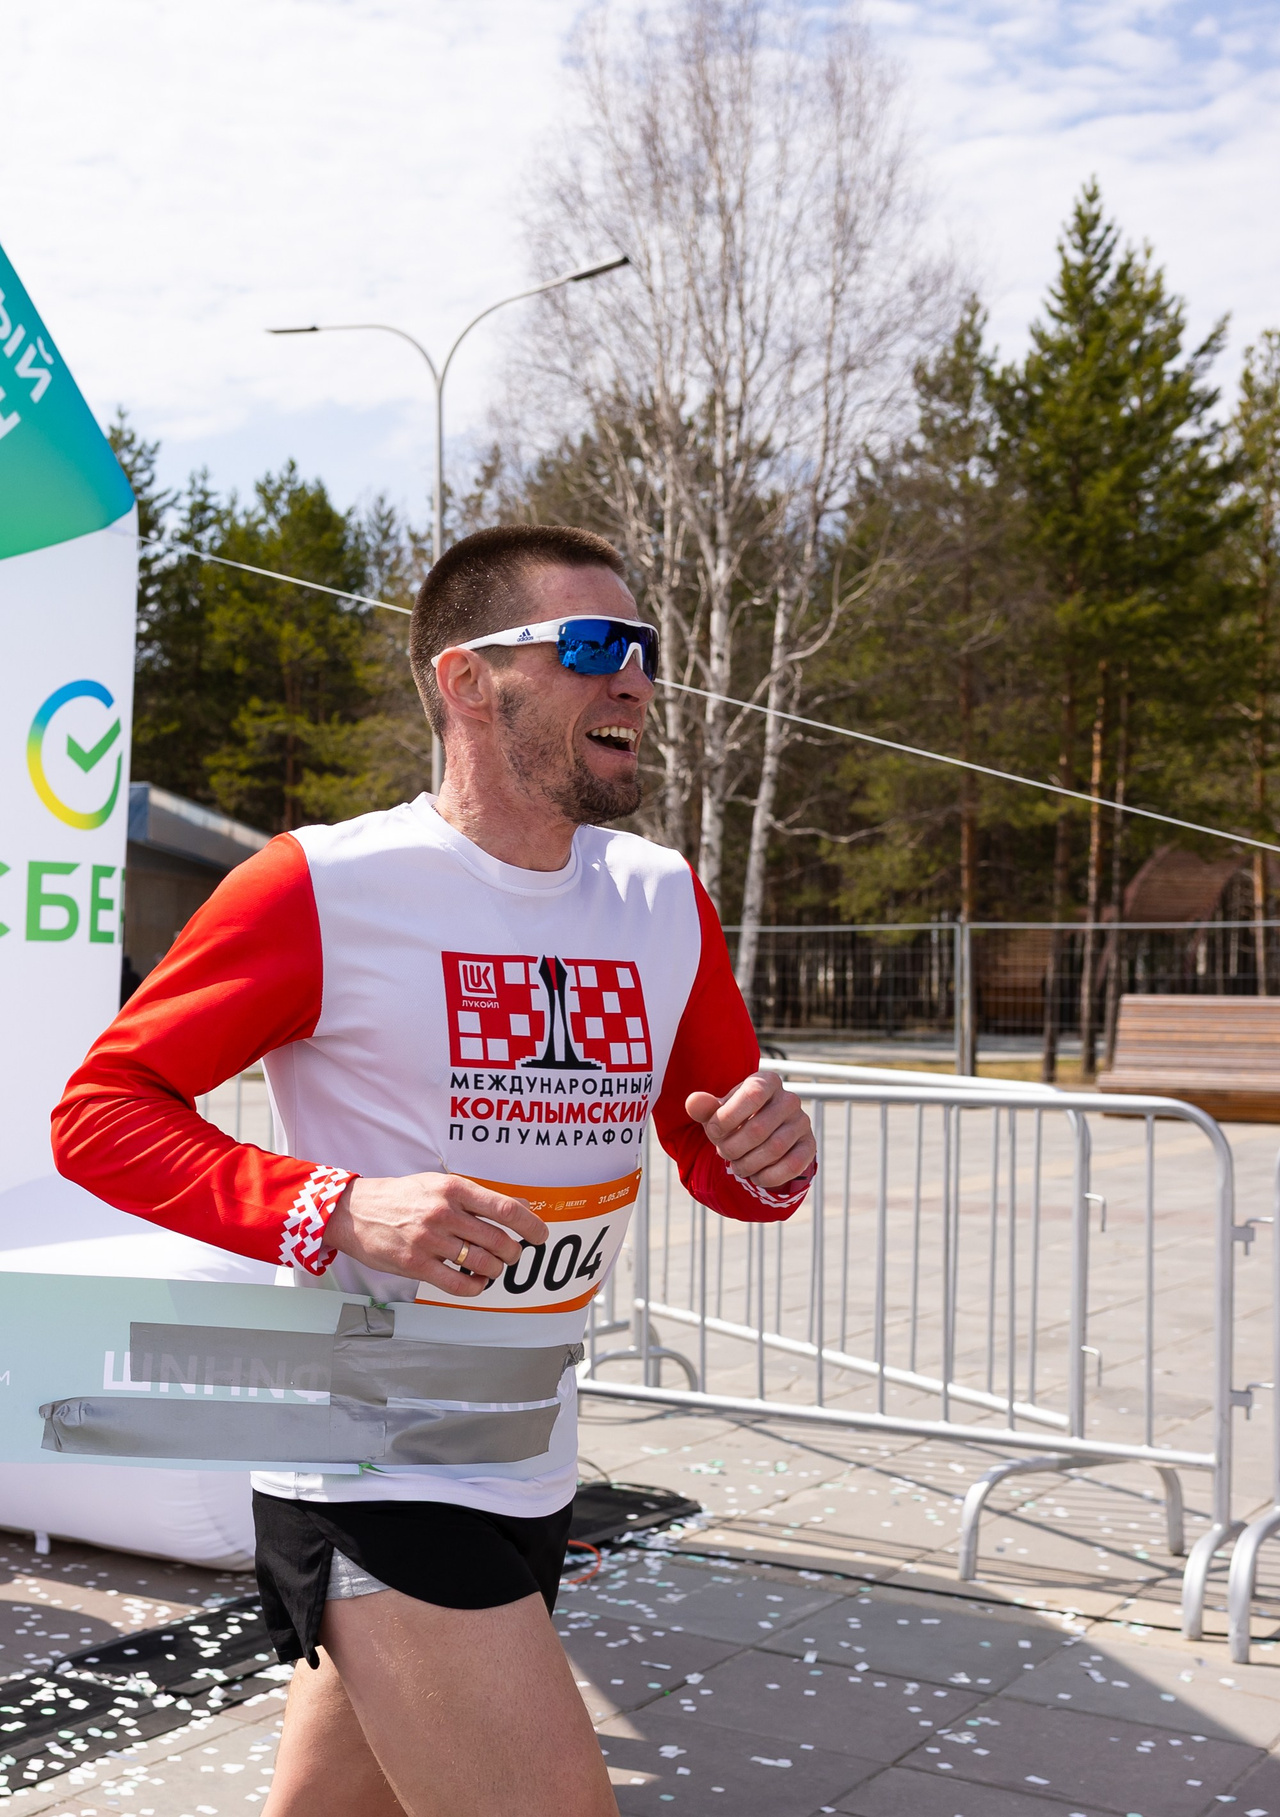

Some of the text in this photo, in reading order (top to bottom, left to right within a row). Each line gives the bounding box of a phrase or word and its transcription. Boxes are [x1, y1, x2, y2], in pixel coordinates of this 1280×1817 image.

[516, 635, 534, 643] adidas
[461, 999, 500, 1009] ЛУКОЙЛ
[450, 1072, 653, 1097] МЕЖДУНАРОДНЫЙ
[450, 1094, 650, 1124] КОГАЛЫМСКИЙ
[598, 1187, 630, 1205] 31.05.2025
[460, 1225, 610, 1294] 004
